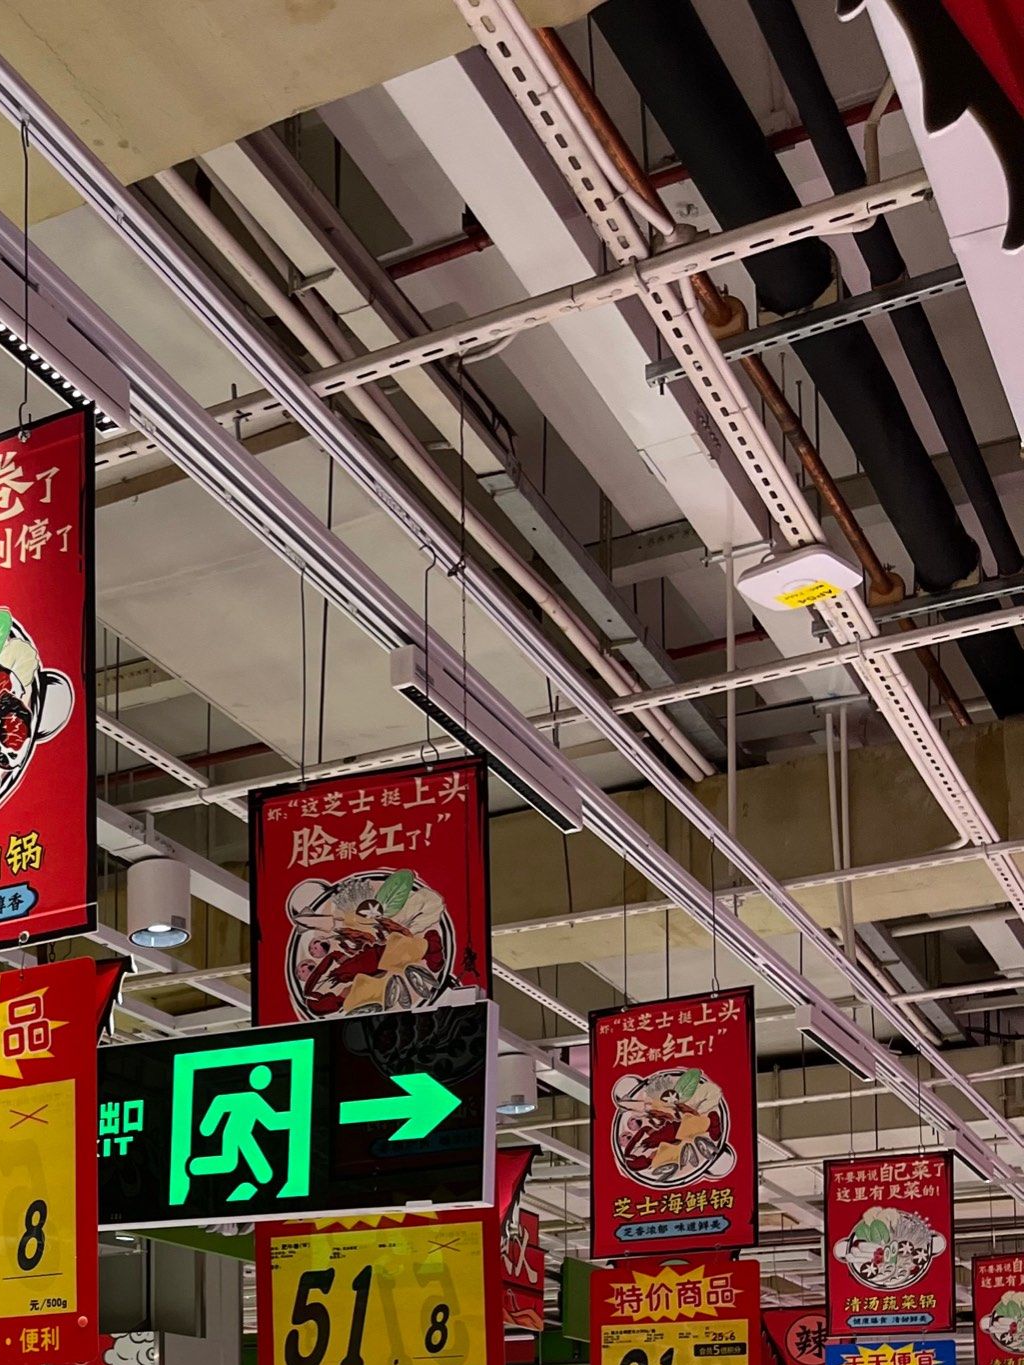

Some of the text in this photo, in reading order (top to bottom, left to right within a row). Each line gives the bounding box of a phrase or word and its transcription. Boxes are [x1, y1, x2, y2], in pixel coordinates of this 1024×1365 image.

[99, 1100, 144, 1136] 出口
[97, 1136, 133, 1157] IT
[833, 1160, 945, 1183] 不要再说自己菜了
[613, 1189, 733, 1219] 芝士海鲜锅
[30, 1298, 67, 1312] 元/500g
[615, 1277, 733, 1314] 特价商品
[845, 1294, 937, 1312] 清汤蔬菜锅
[795, 1321, 825, 1359] 辣
